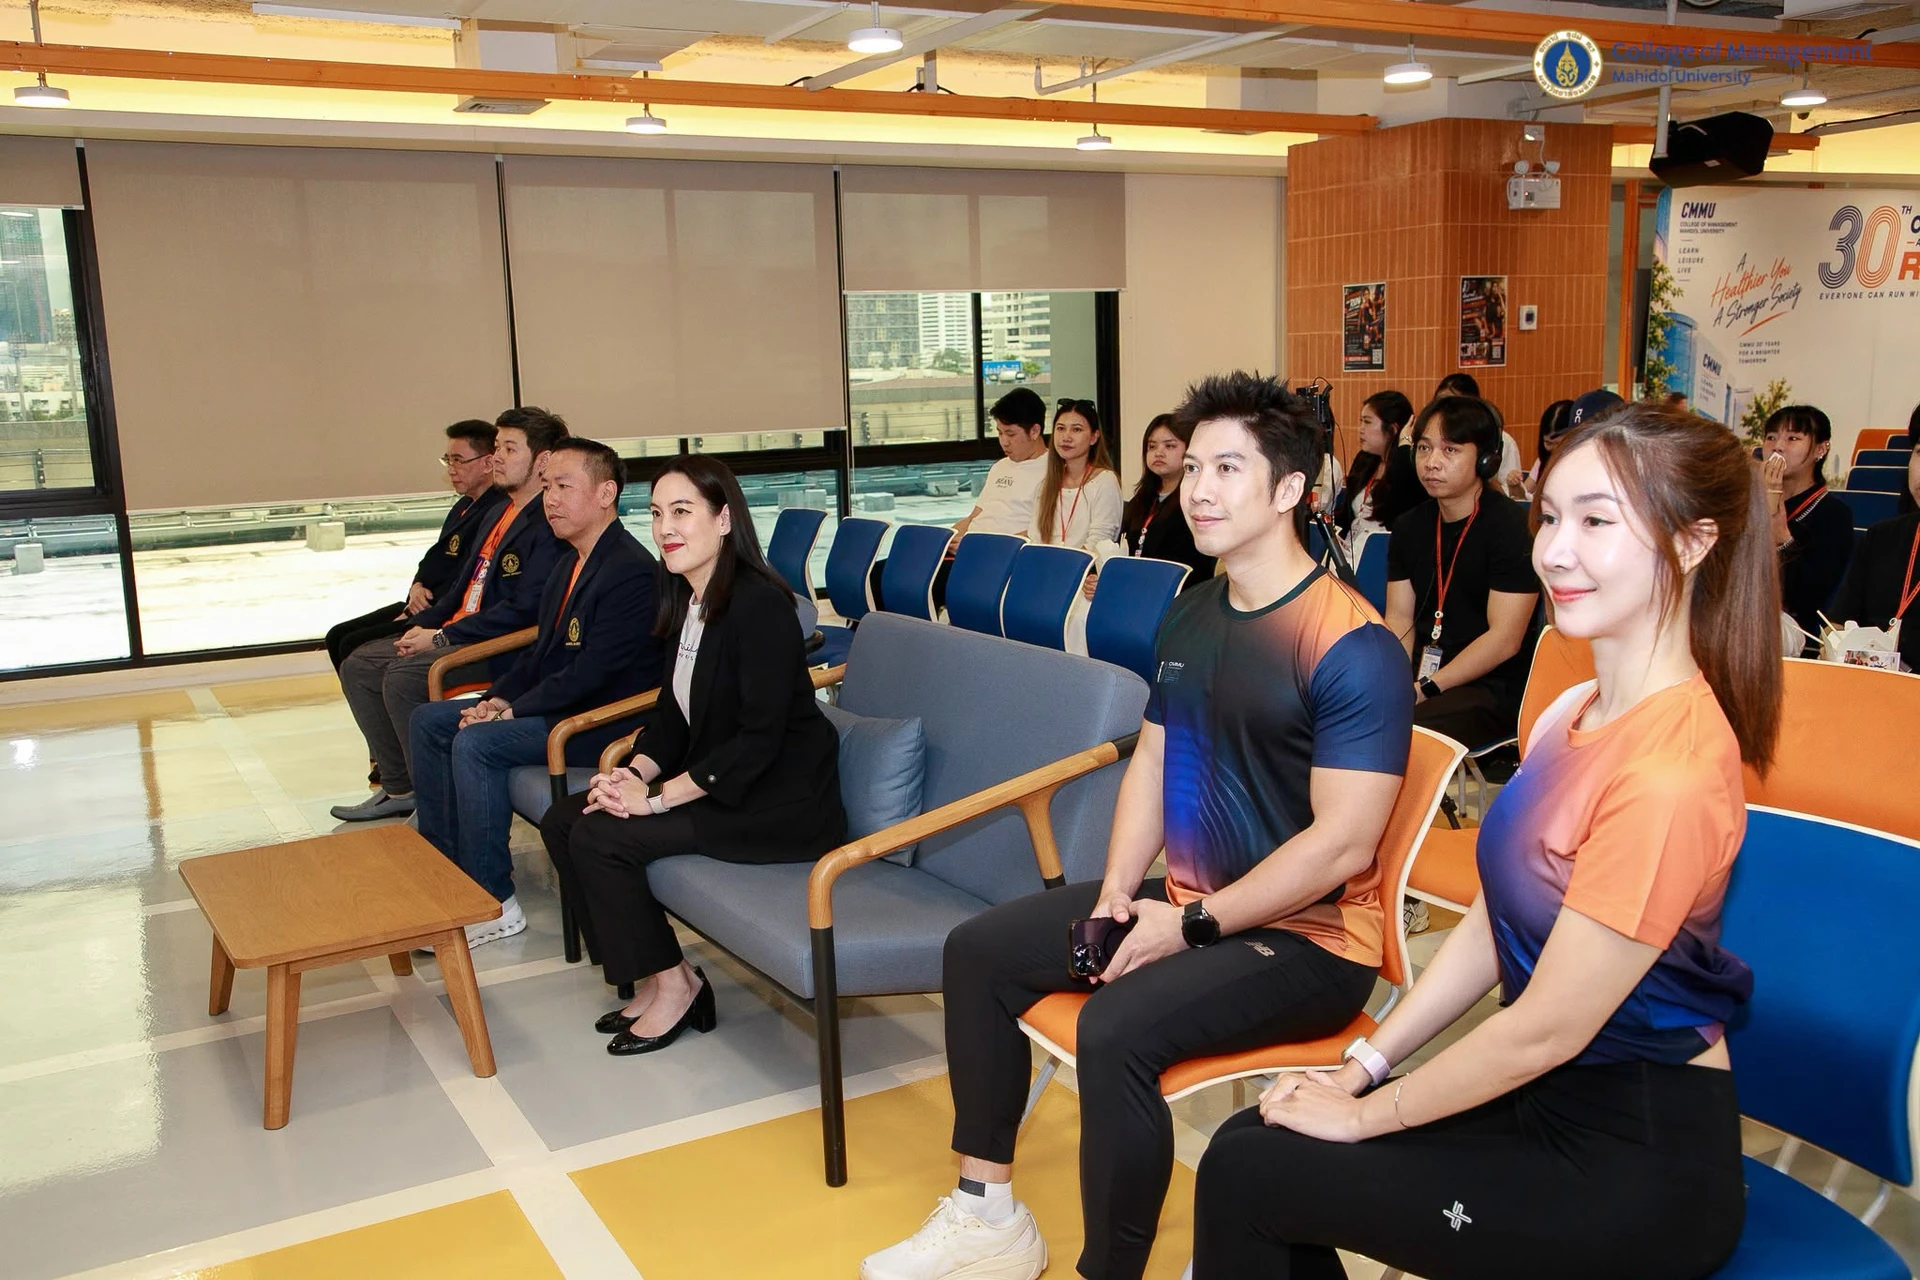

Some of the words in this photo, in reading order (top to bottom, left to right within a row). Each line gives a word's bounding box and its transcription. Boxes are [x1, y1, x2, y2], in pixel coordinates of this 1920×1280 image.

[1681, 202, 1717, 219] CMMU
[1818, 205, 1901, 290] 30
[1901, 205, 1913, 215] TH
[1711, 264, 1768, 308] Healthier
[1771, 255, 1792, 290] You
[1819, 292, 1863, 300] EVERYONE
[1868, 291, 1885, 299] CAN
[1713, 306, 1724, 327] A
[1725, 298, 1769, 328] Stronger
[1771, 282, 1803, 311] Society
[1703, 353, 1722, 376] CMMU
